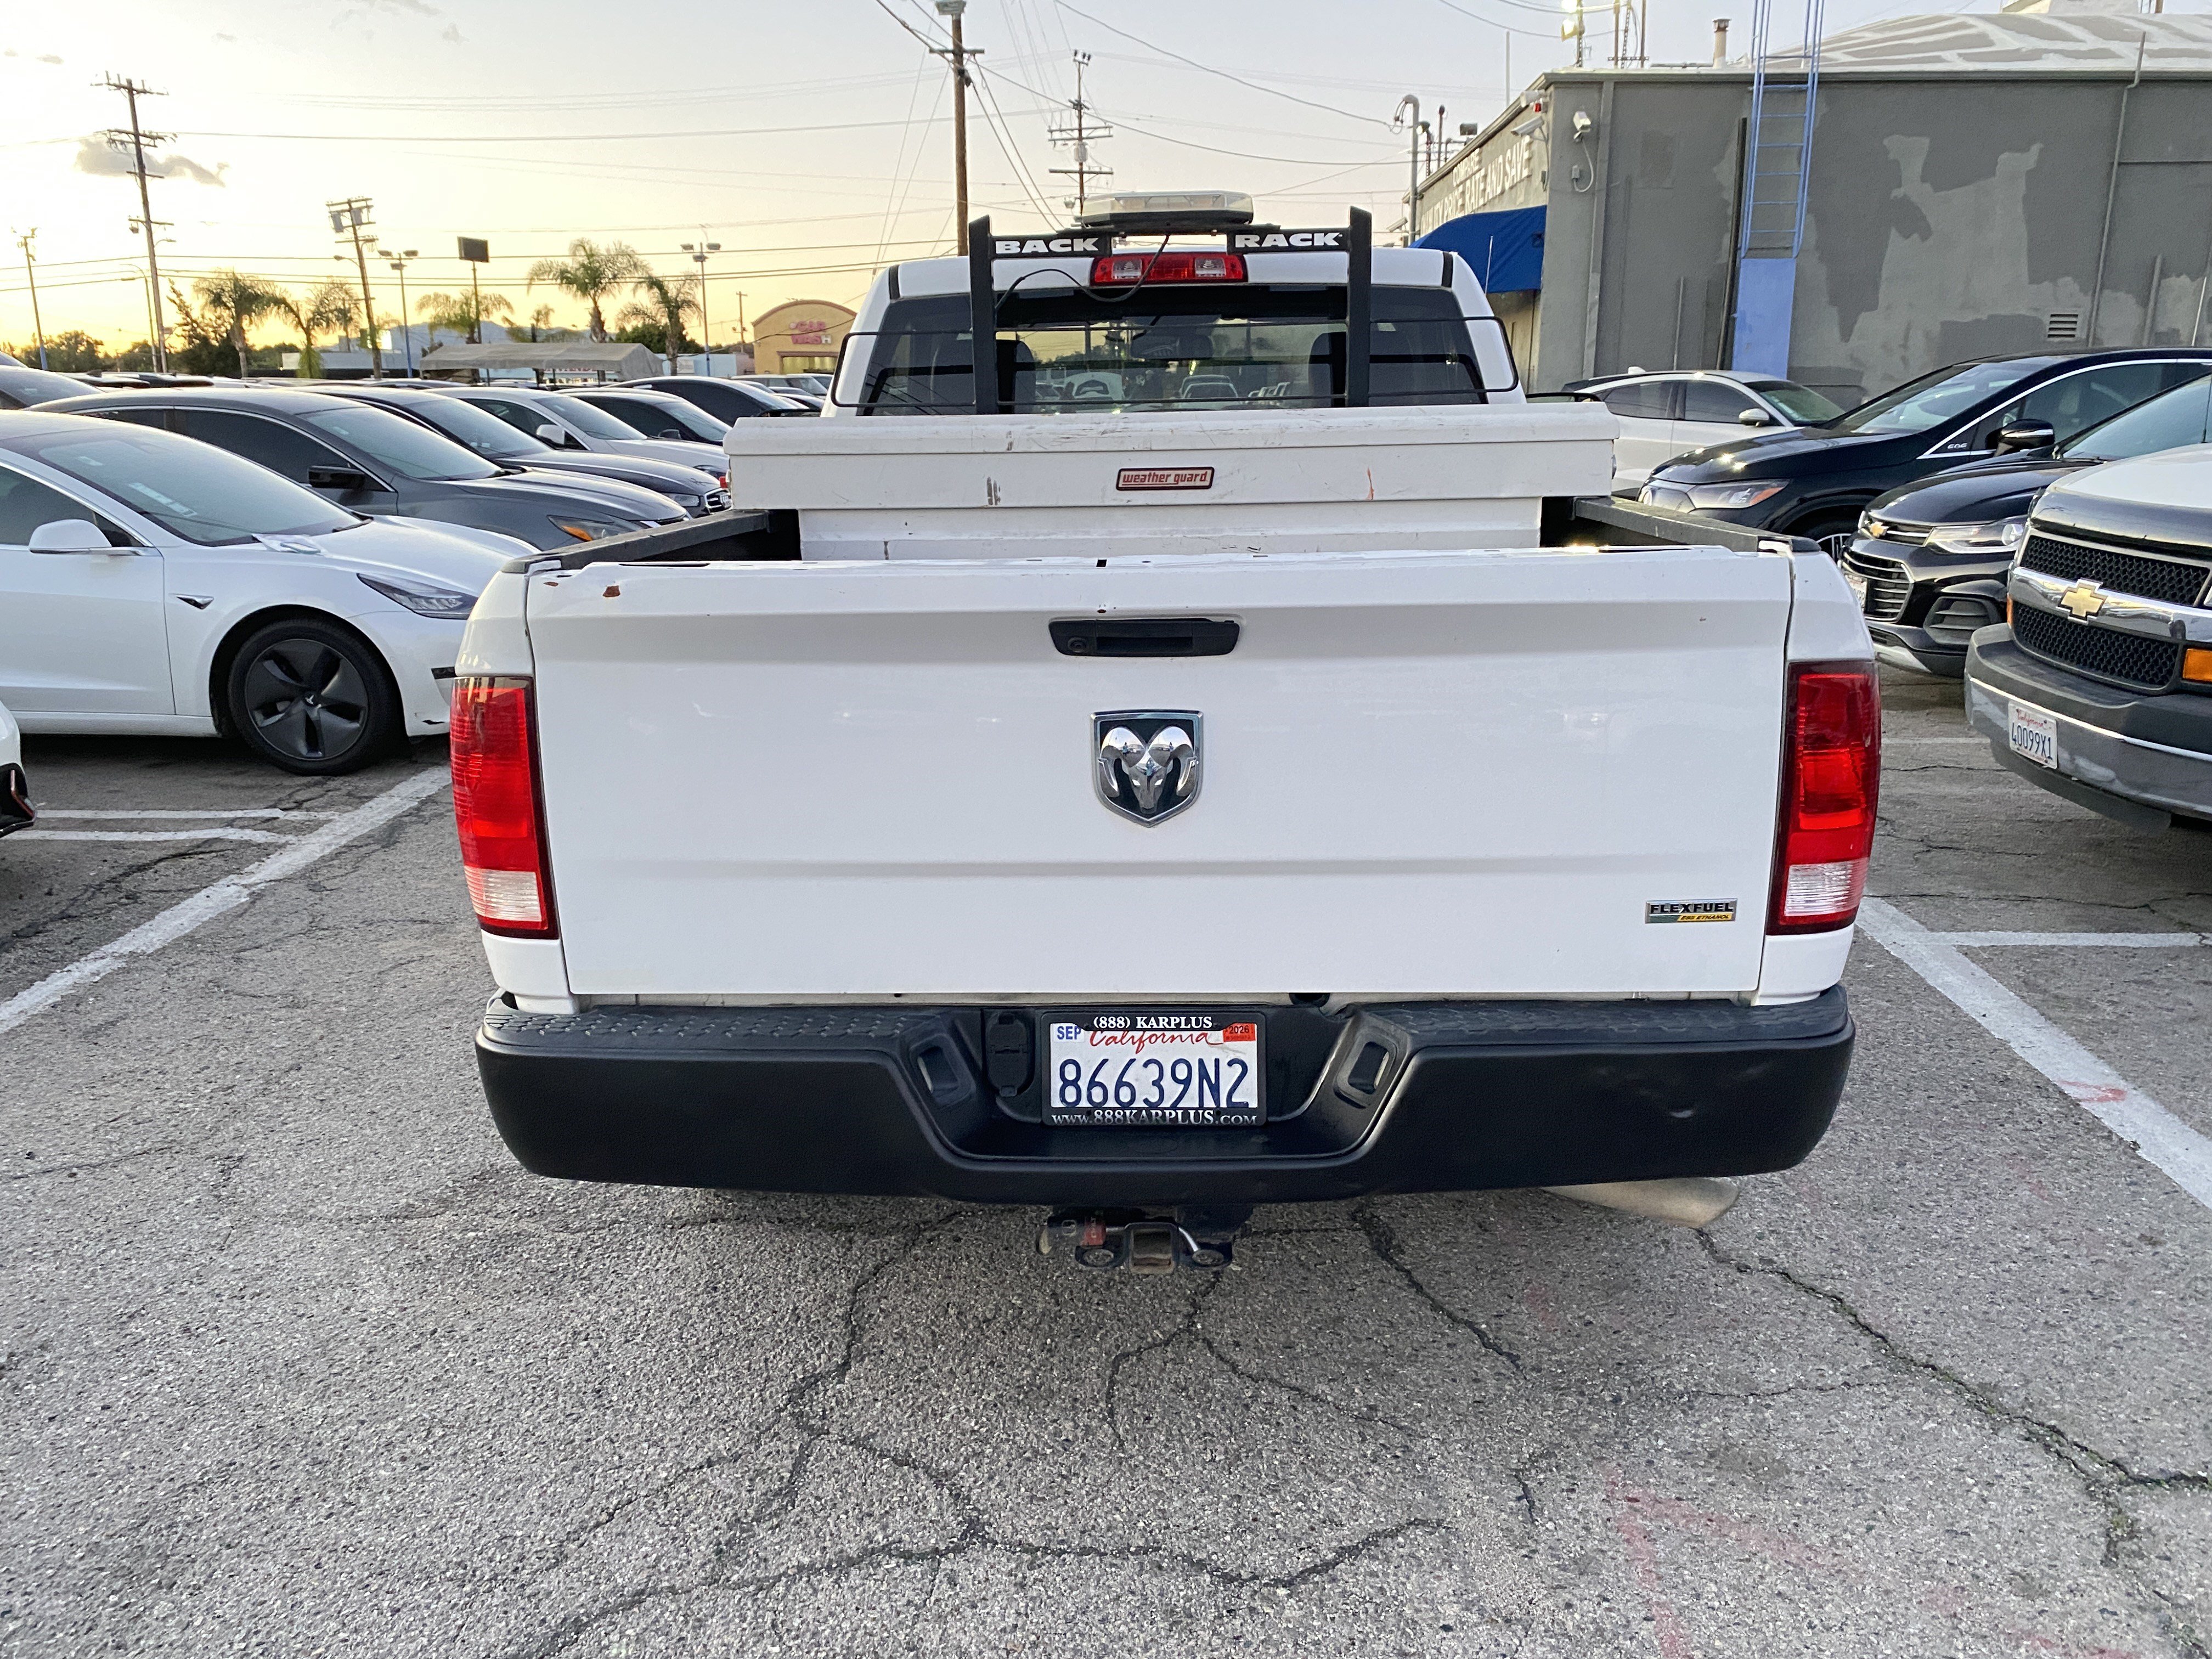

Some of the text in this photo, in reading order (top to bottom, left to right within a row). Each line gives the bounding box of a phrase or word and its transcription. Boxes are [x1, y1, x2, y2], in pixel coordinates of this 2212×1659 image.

[1465, 167, 1485, 216] RATE
[1485, 154, 1504, 203] AND
[1504, 134, 1531, 190] SAVE
[995, 238, 1099, 254] BACK
[1234, 232, 1339, 248] RACK
[797, 320, 826, 332] CAR
[1122, 471, 1209, 484] weather guard
[2011, 722, 2053, 760] 40099X1
[1650, 902, 1734, 913] FLEXFUEL
[1093, 1016, 1212, 1029] (888) KARPLUS
[1228, 1025, 1250, 1035] 2026
[1057, 1025, 1082, 1040] SEP
[1089, 1030, 1224, 1054] California
[1058, 1057, 1250, 1108] 86639N2
